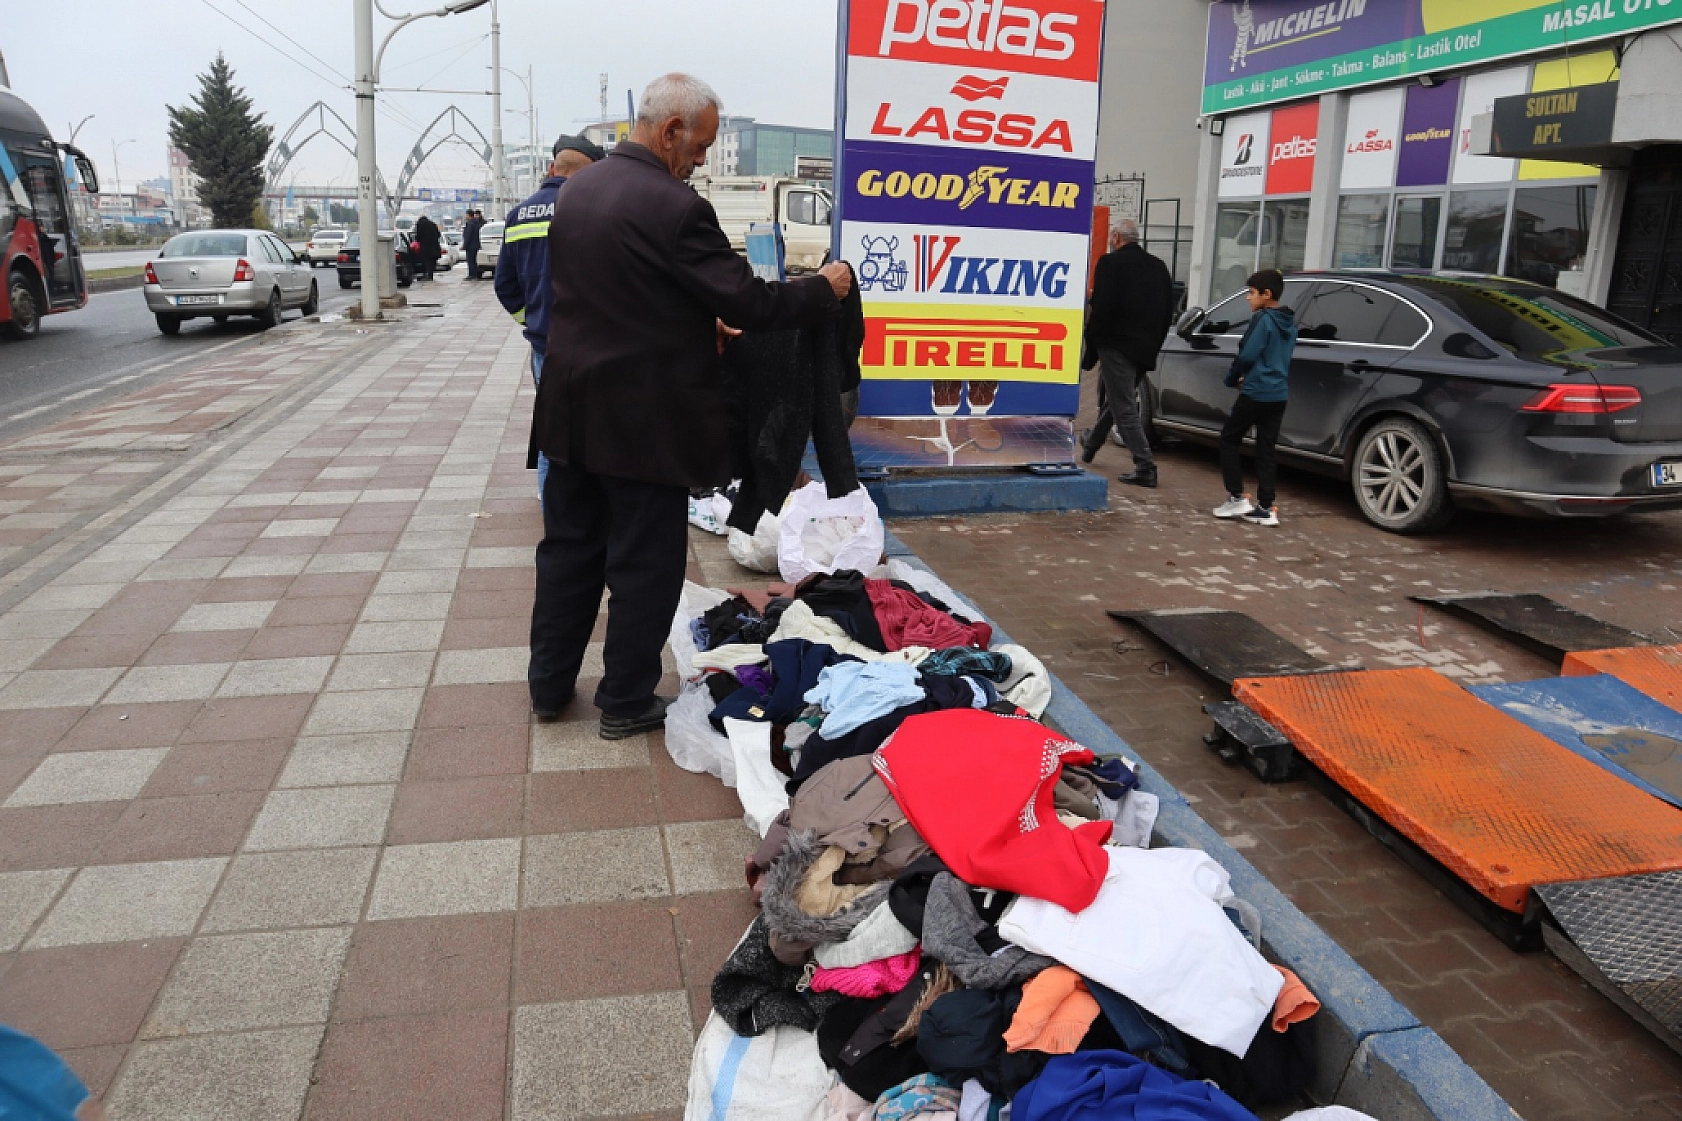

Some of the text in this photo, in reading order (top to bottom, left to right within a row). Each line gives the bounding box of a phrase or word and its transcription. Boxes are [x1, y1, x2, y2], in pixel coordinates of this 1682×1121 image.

[878, 0, 1078, 61] petlas
[1254, 0, 1367, 45] MICHELIN
[1542, 0, 1616, 33] MASAL
[1224, 84, 1244, 100] Lastik
[1270, 75, 1289, 92] Jant
[1331, 60, 1364, 78] Takma
[1372, 51, 1407, 69] Balans
[1416, 37, 1451, 60] Lastik
[1454, 29, 1482, 51] Otel
[870, 102, 1073, 153] LASSA
[1526, 92, 1578, 118] SULTAN
[1269, 135, 1317, 166] petlas
[1347, 139, 1393, 154] LASSA
[1533, 123, 1561, 145] APT.
[913, 234, 1070, 299] VIKING
[862, 316, 1068, 371] PIRELLI
